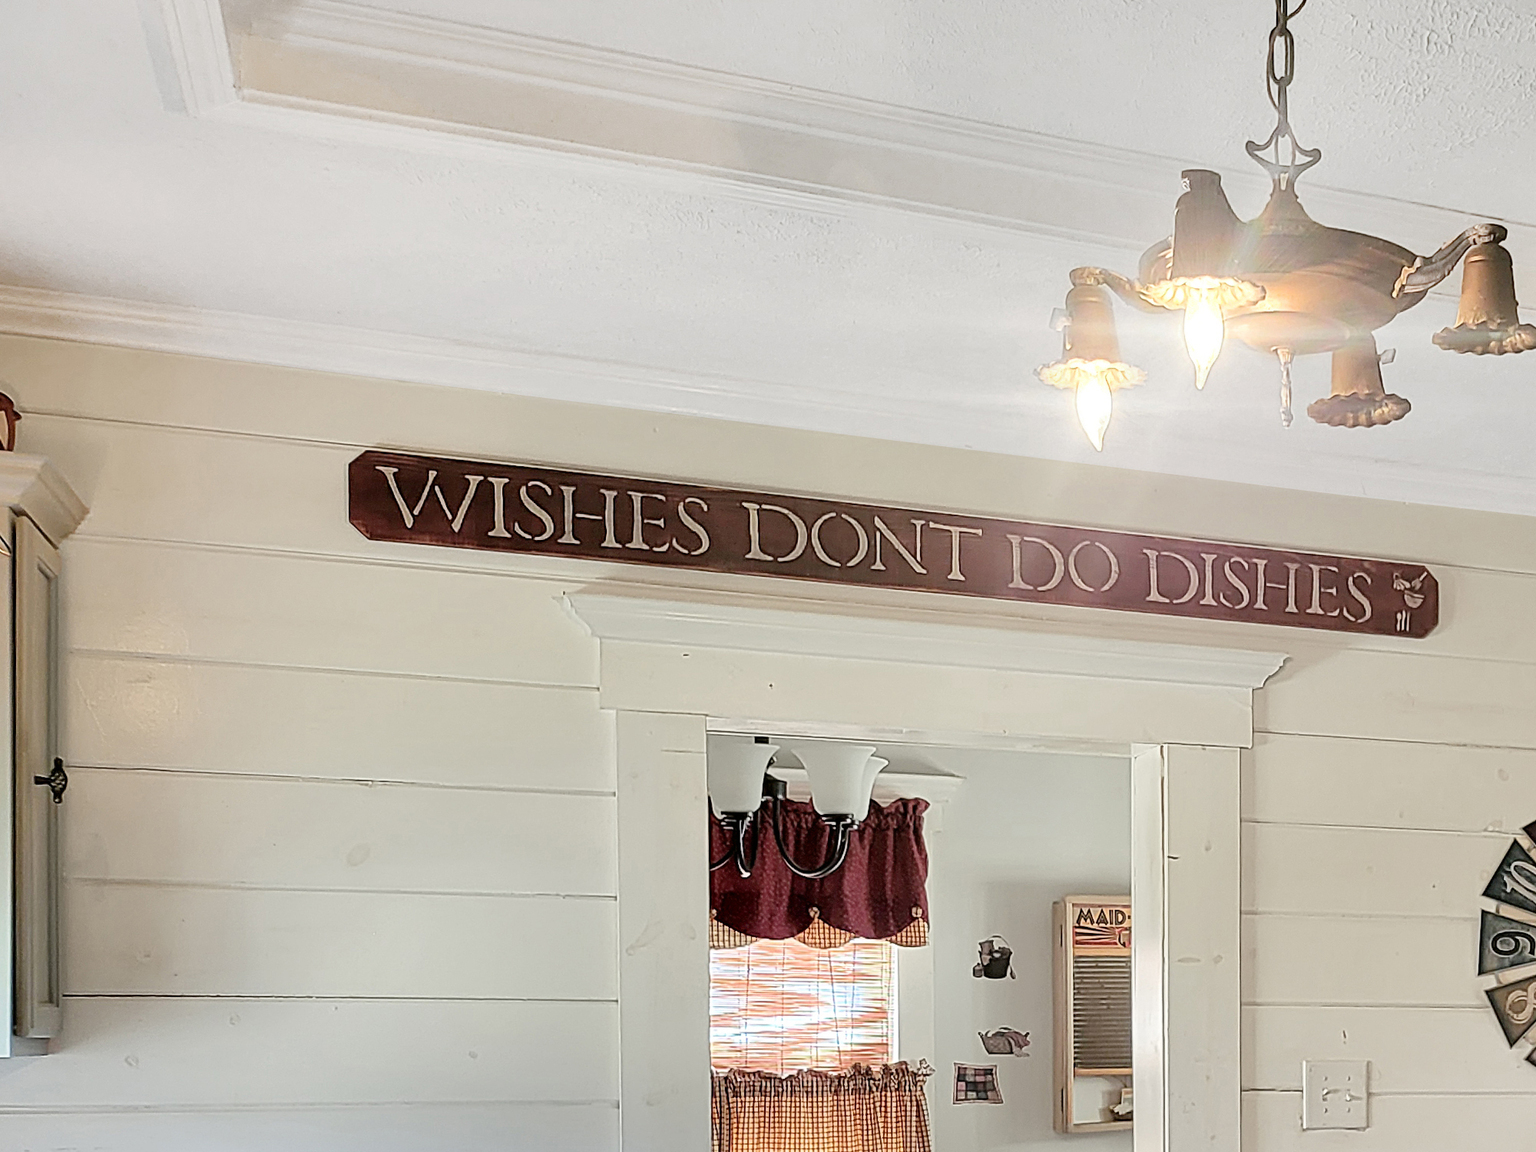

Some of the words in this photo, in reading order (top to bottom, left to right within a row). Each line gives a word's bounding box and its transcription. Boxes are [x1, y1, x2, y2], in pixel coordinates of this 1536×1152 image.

[375, 465, 712, 556] WISHES
[741, 501, 983, 582] DONT
[1005, 533, 1120, 593] DO
[1142, 548, 1373, 624] DISHES
[1490, 930, 1536, 958] 9
